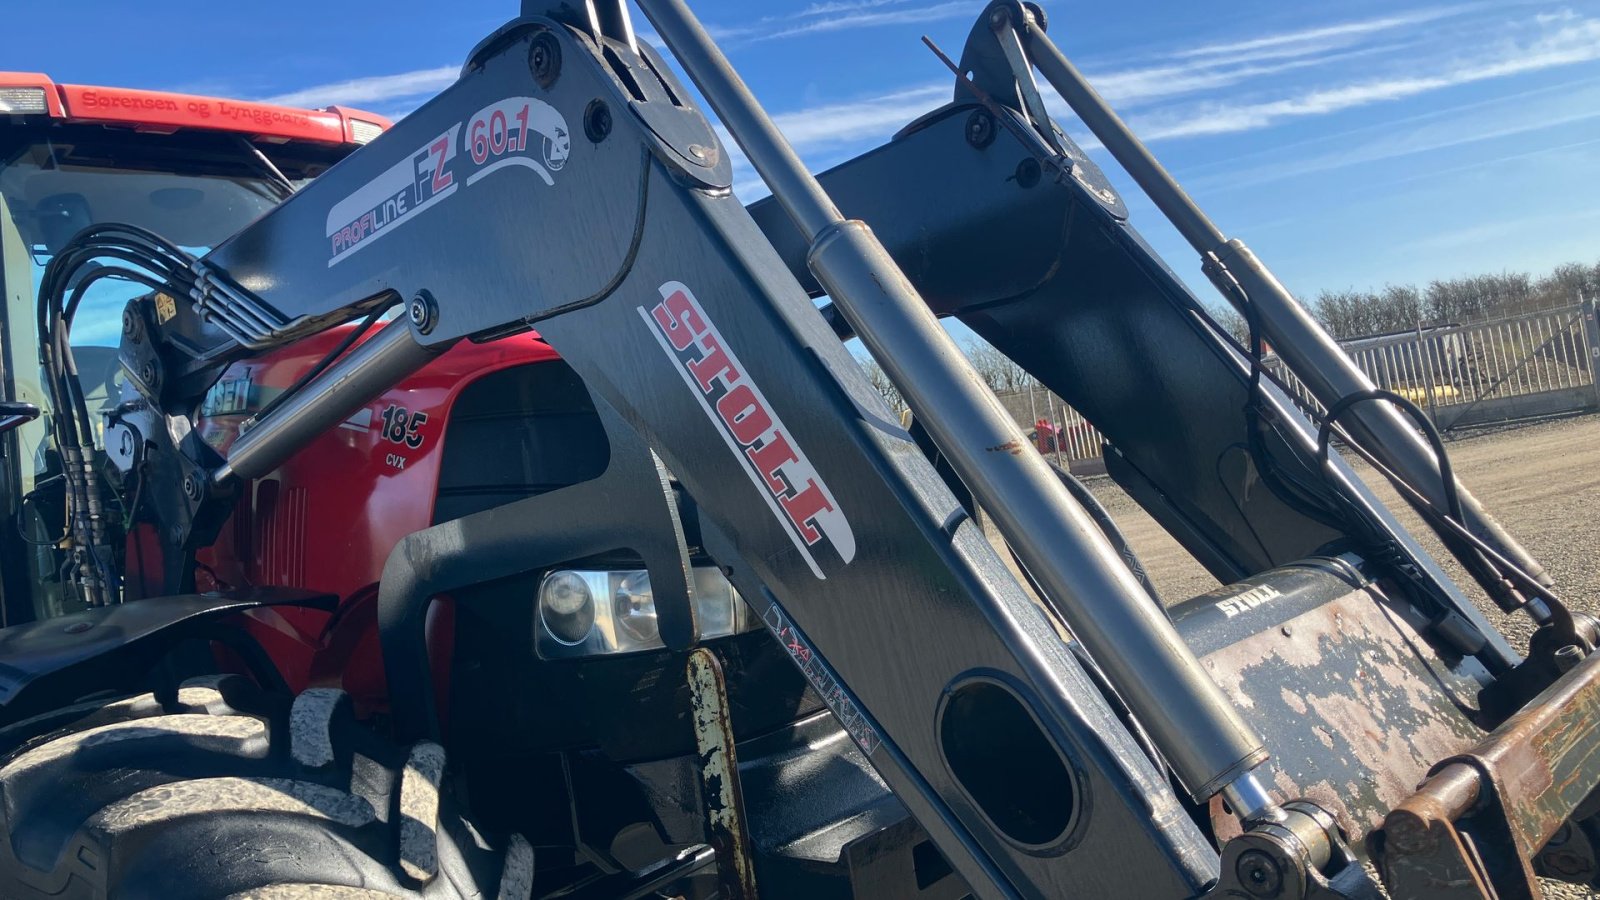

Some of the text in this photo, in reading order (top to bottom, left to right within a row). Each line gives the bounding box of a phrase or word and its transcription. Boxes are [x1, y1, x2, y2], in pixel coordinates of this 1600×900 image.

[82, 91, 178, 112] Sørensen
[188, 102, 210, 118] og
[413, 136, 453, 205] FZ
[470, 104, 529, 165] 60.1
[381, 403, 428, 449] 185
[651, 289, 834, 546] STOLL
[386, 453, 406, 470] CVX
[1215, 584, 1283, 618] STOLL
